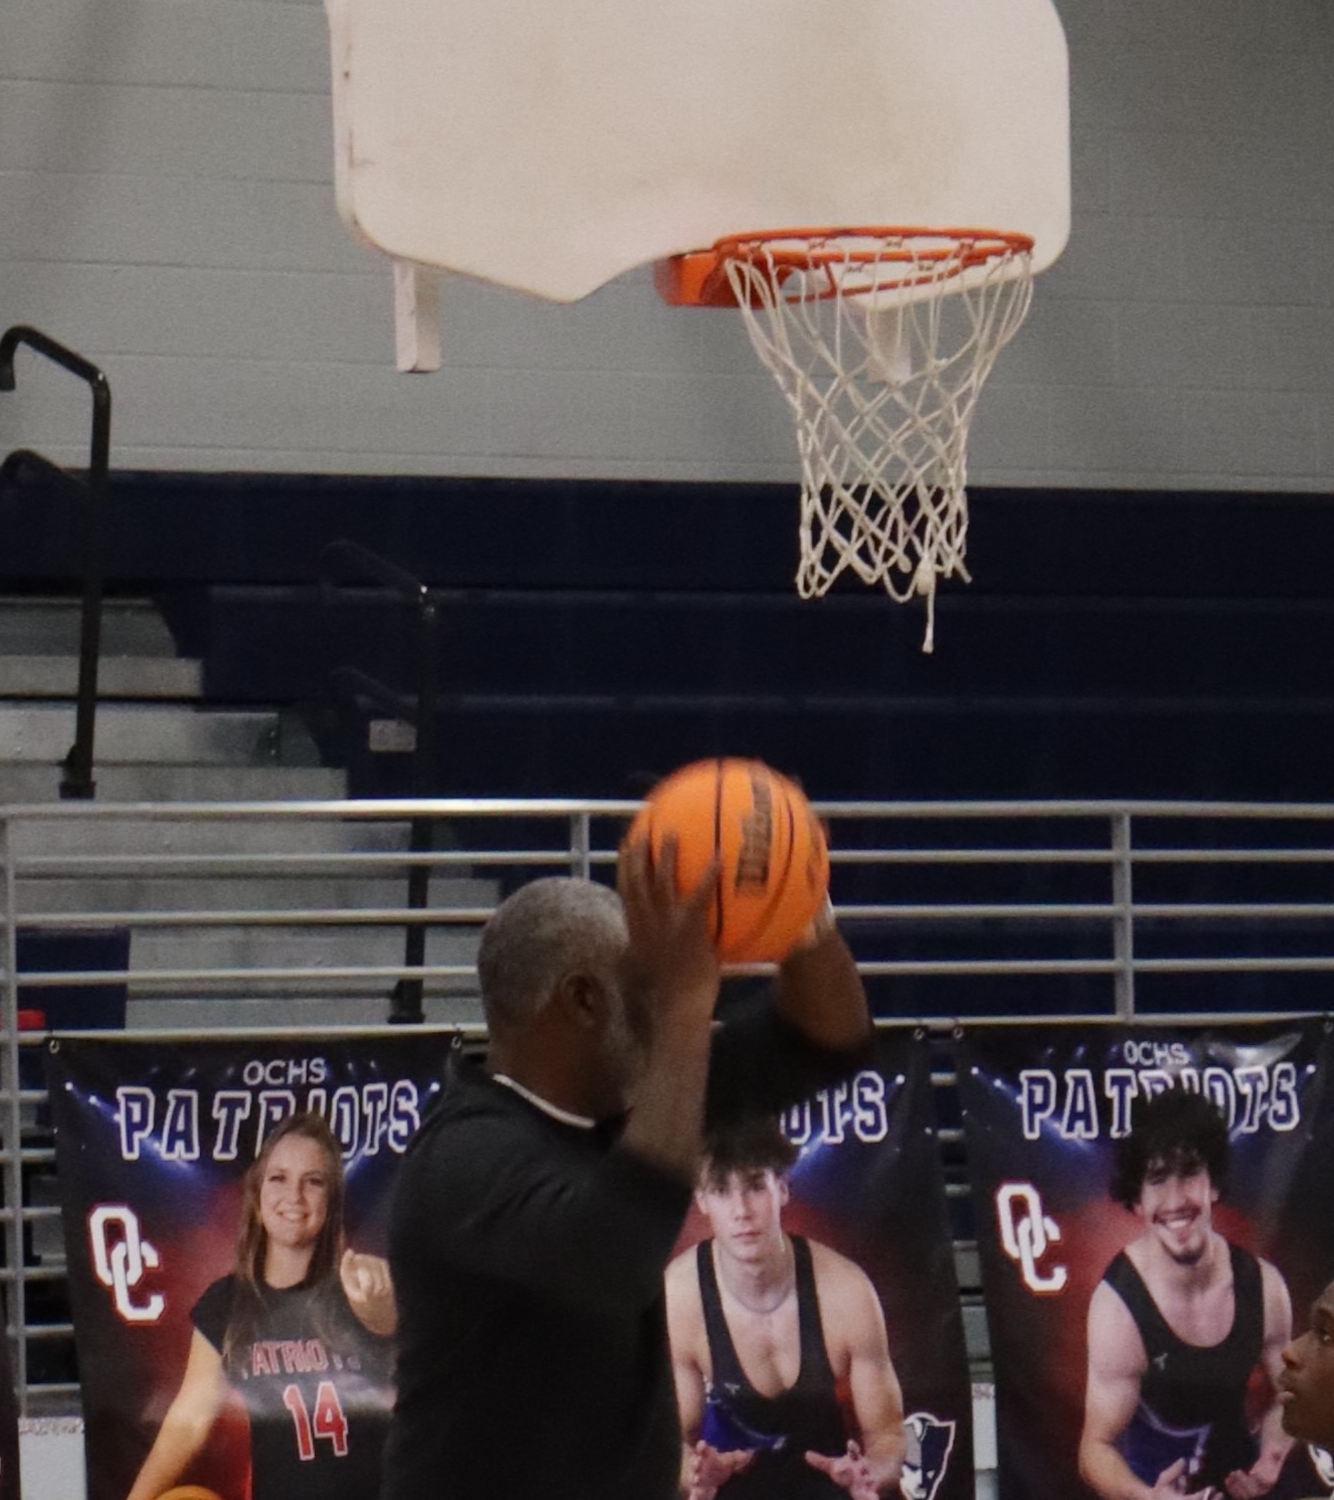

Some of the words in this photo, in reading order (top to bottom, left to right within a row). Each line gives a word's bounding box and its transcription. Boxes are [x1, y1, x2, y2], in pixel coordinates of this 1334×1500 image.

[242, 1057, 328, 1086] OCHS
[1123, 1040, 1191, 1065] OCHS
[88, 1204, 166, 1322] OC
[996, 1181, 1067, 1293] OC
[283, 1380, 349, 1461] 14
